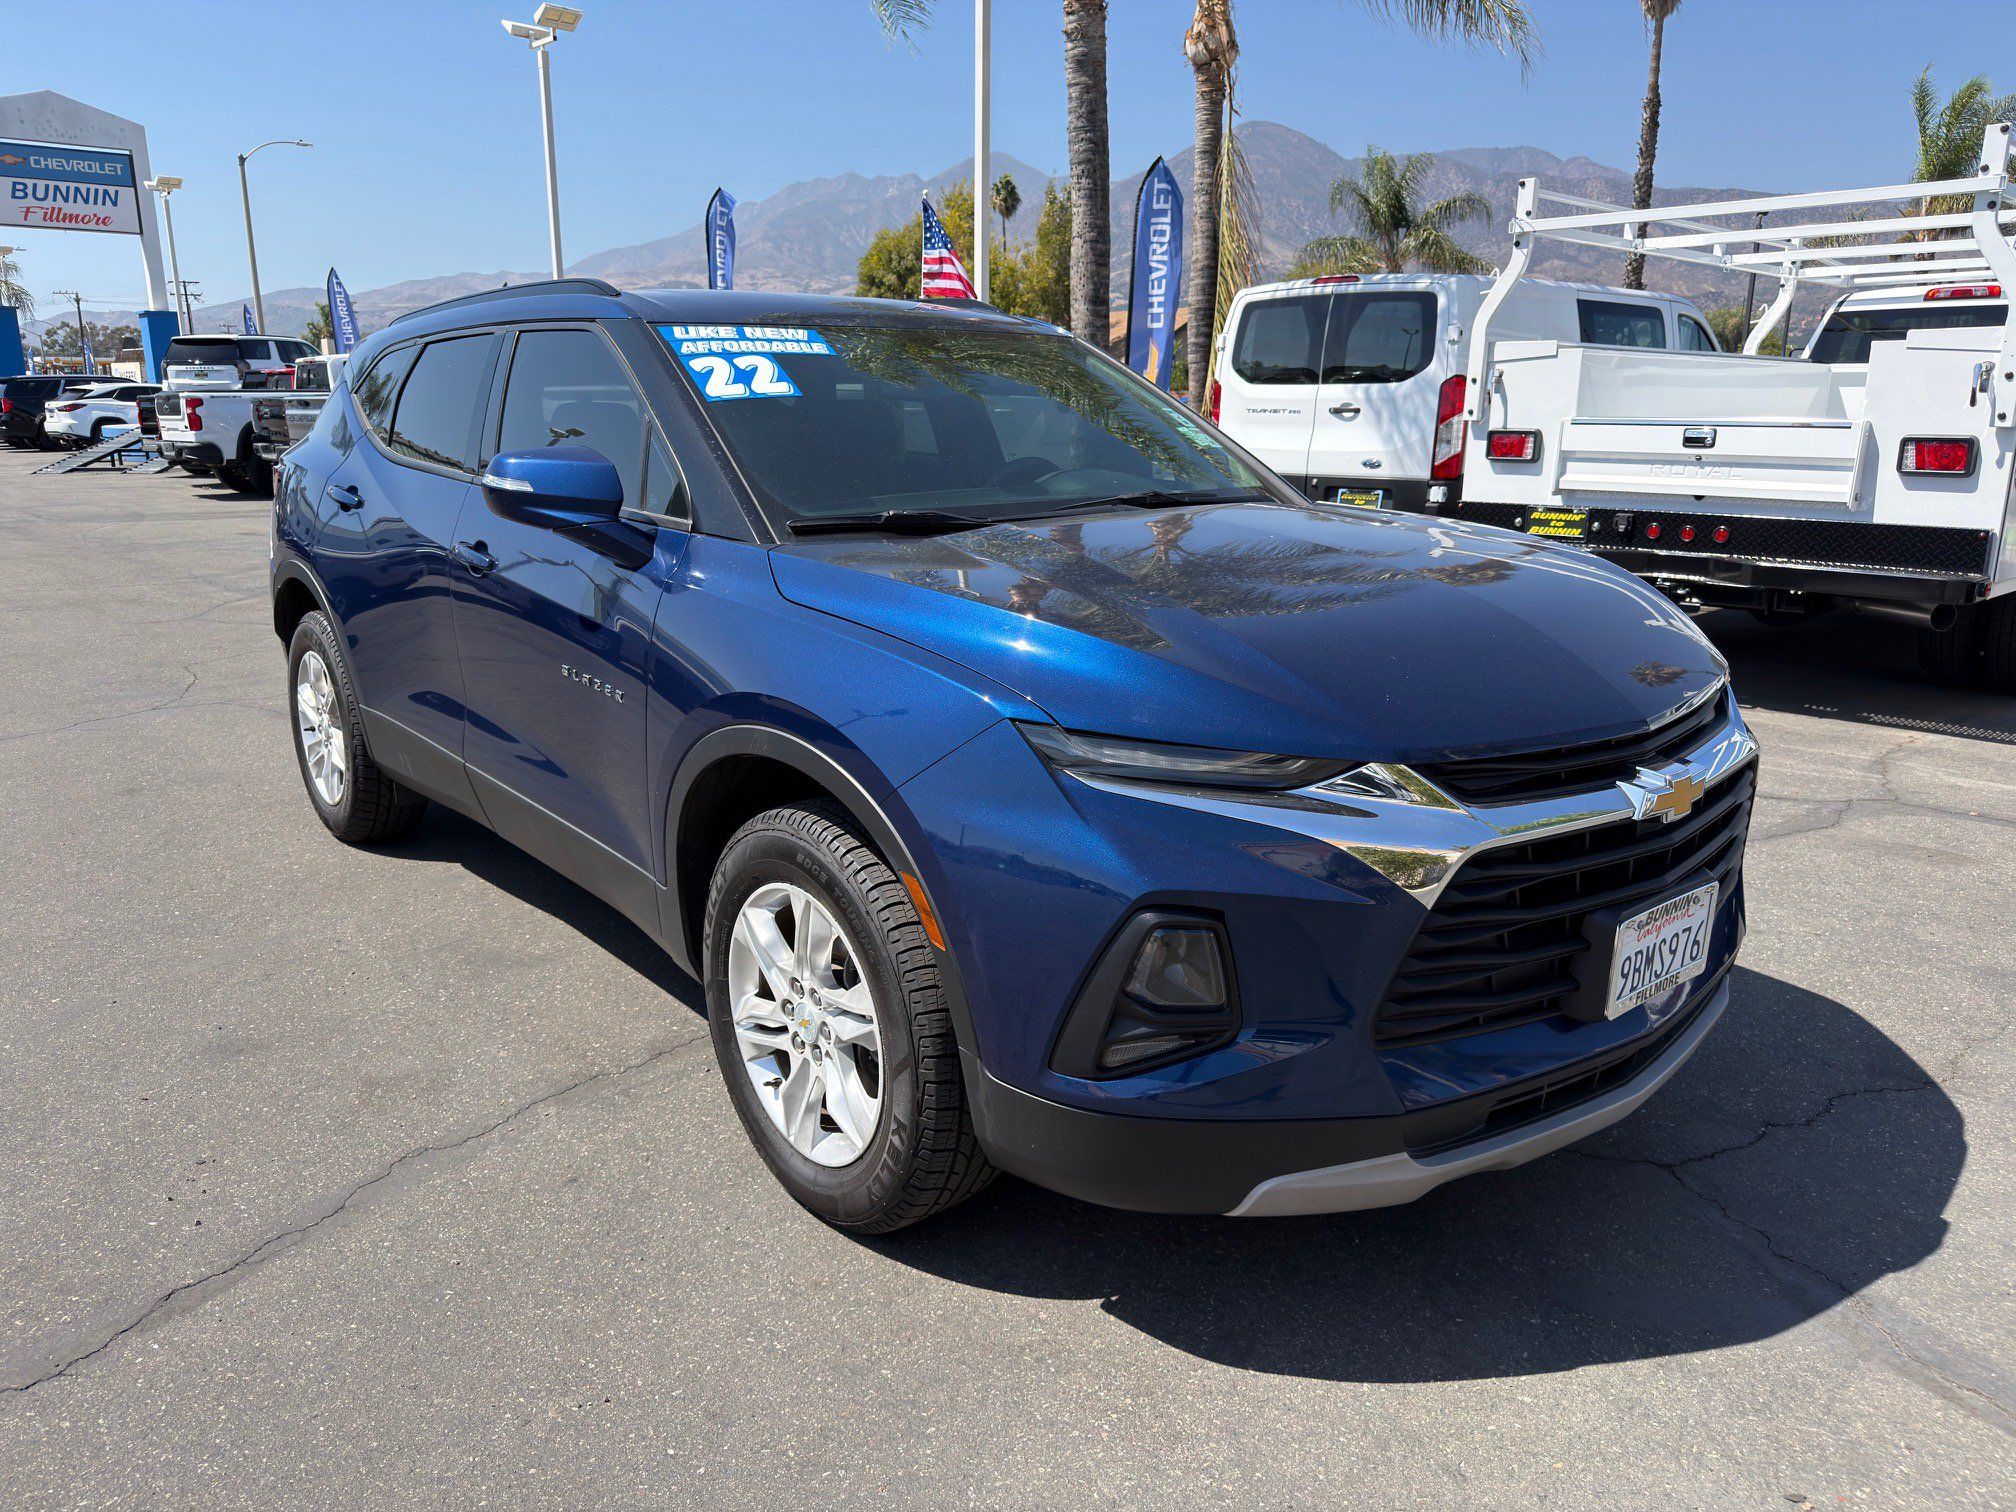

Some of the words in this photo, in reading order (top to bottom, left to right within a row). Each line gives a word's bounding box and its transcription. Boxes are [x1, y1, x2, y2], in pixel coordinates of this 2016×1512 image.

[30, 156, 123, 176] CHEVROLET
[11, 181, 119, 207] BUNNIN
[18, 206, 113, 227] Fillmore
[716, 201, 729, 290] EVROLET
[1146, 177, 1173, 330] CHEVROLET
[333, 276, 355, 344] CHEVROLET
[672, 326, 739, 339] LIKE
[743, 327, 808, 340] NEW
[680, 340, 830, 354] AFFORDABLE
[688, 354, 794, 397] 22
[1650, 464, 1743, 480] ROYAL
[1528, 525, 1582, 536] BUNNIN
[561, 664, 625, 704] BLAZER
[796, 853, 828, 884] EDGE
[1645, 892, 1695, 924] BUNNIN
[1616, 920, 1705, 1001] 9BMS976
[1634, 972, 1682, 1006] FILLMORE
[867, 1113, 908, 1202] KELLY
